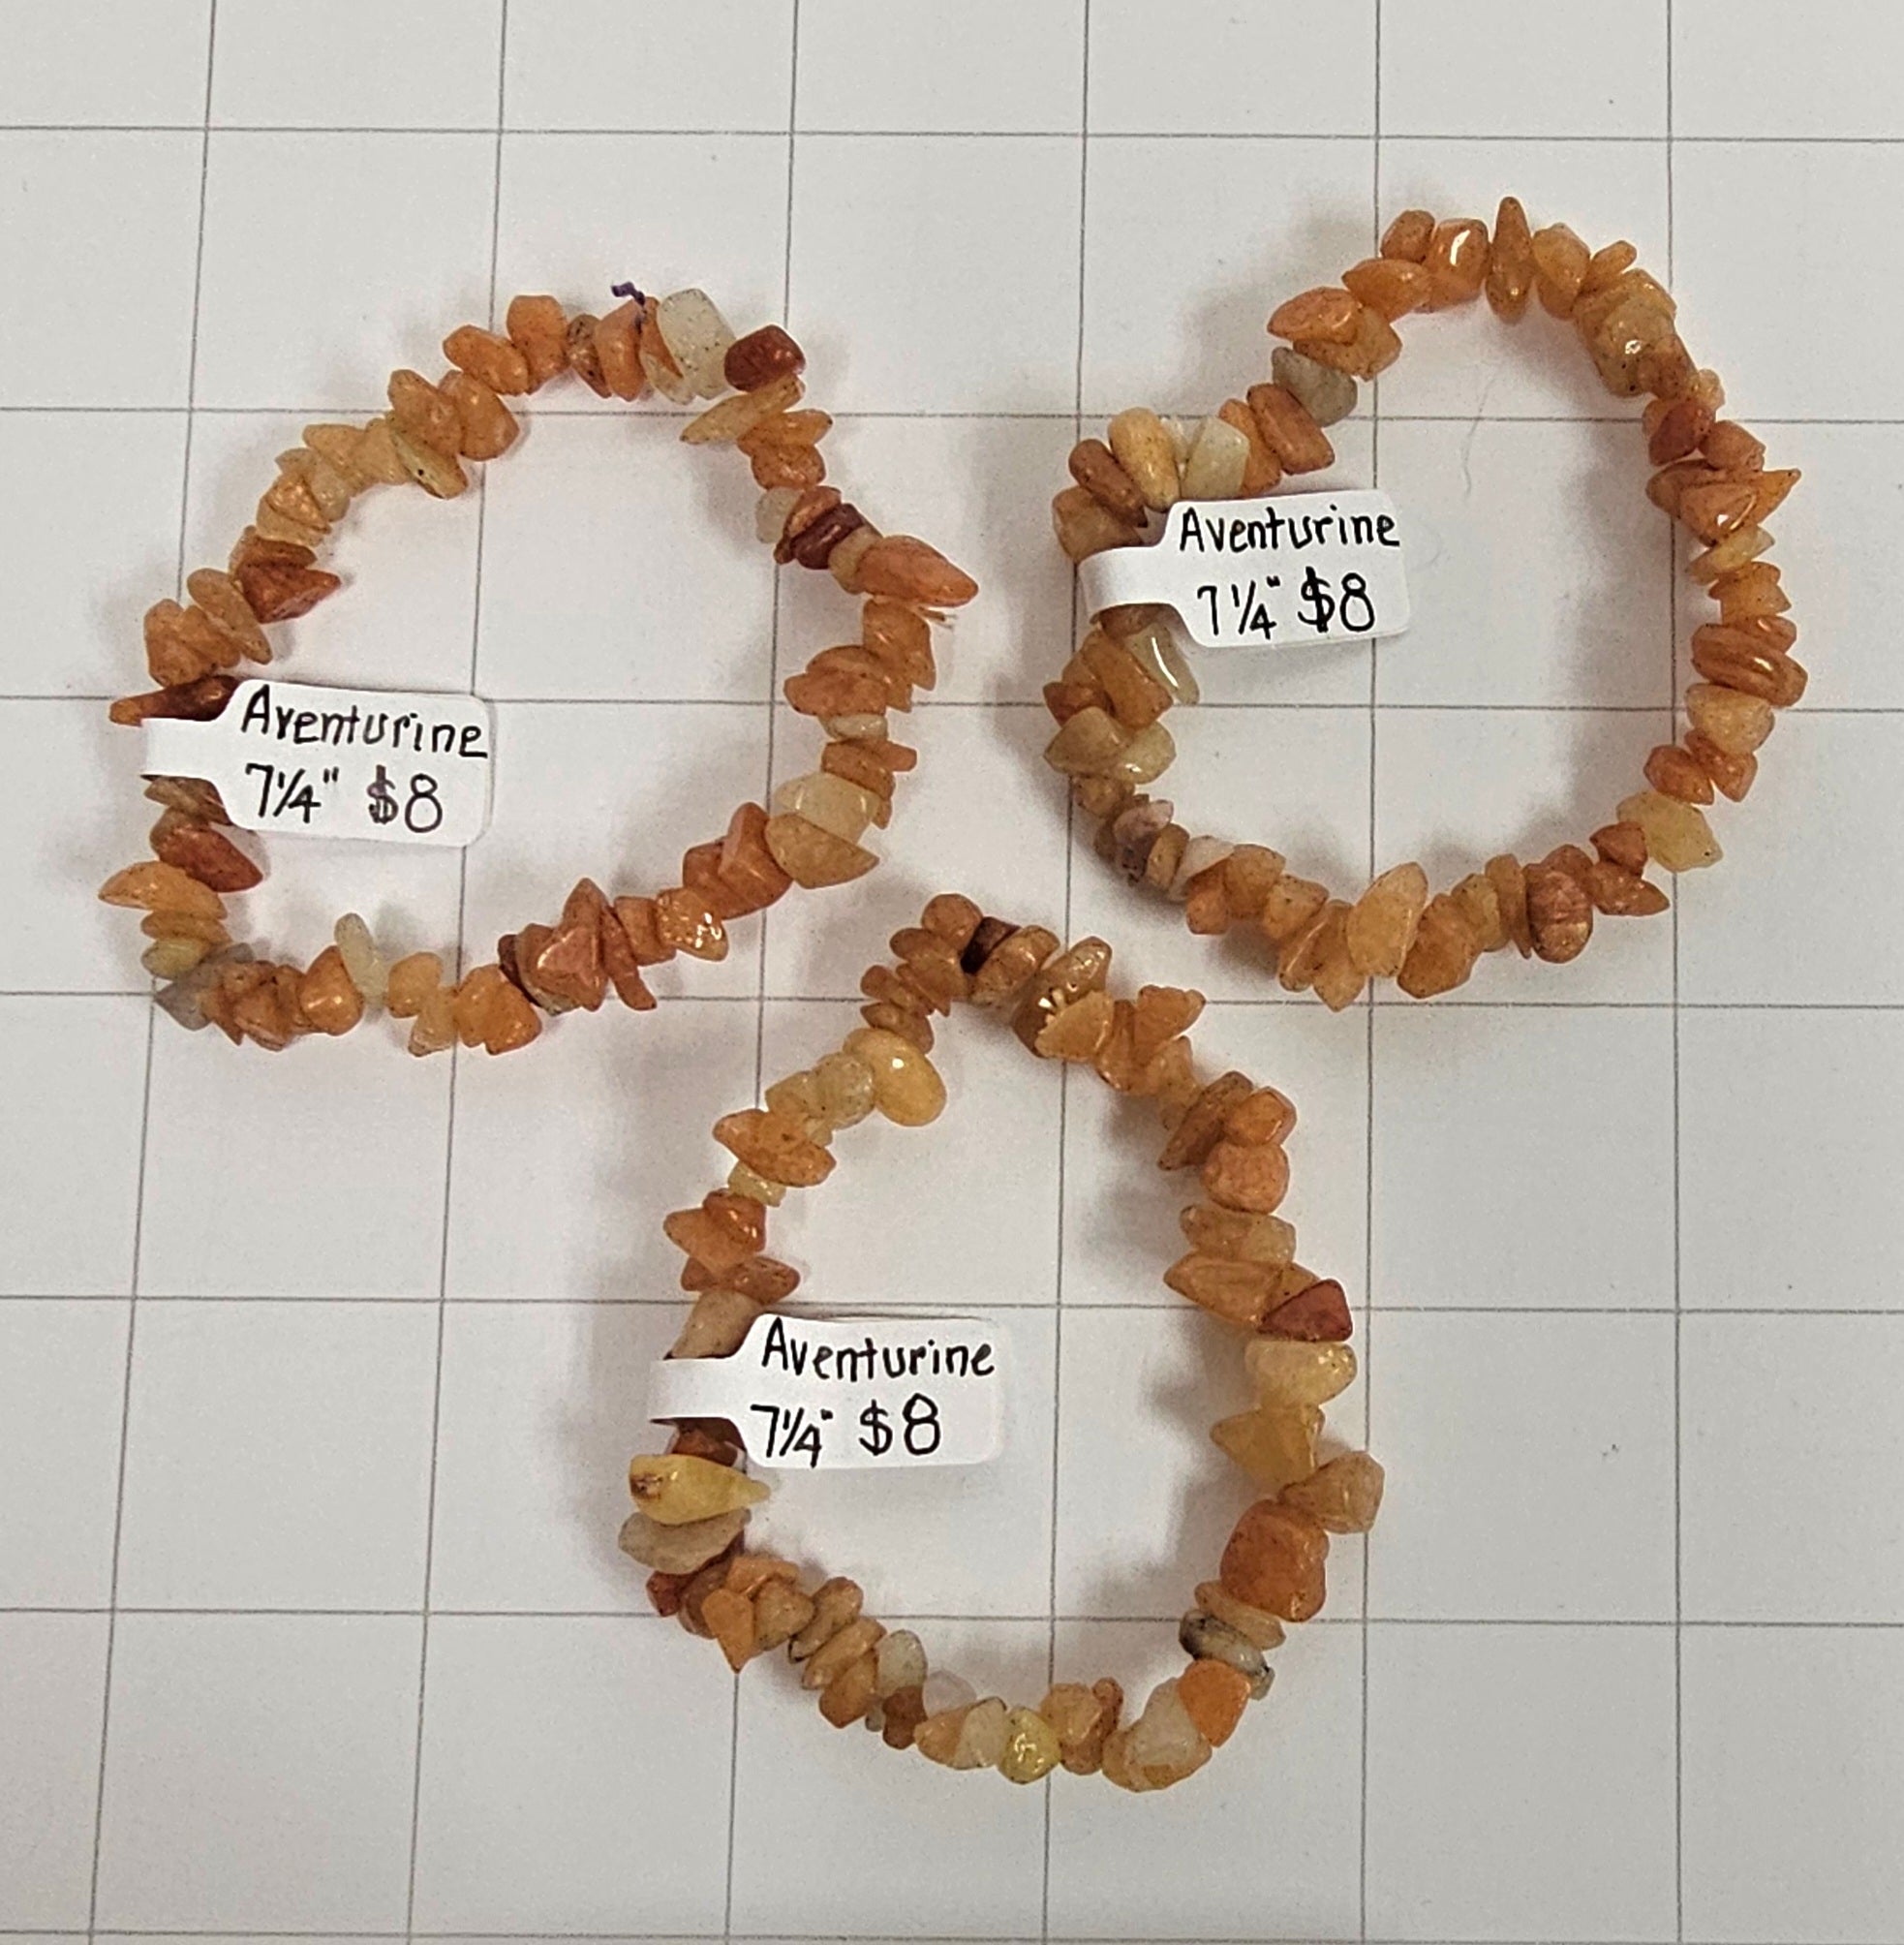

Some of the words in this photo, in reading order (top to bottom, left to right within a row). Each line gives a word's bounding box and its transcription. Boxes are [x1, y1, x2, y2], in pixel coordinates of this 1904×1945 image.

[1179, 504, 1401, 553] Aventurine
[1297, 566, 1376, 633] $8
[240, 684, 489, 759] Aventurine
[367, 764, 444, 833] $8
[761, 1316, 996, 1383] Aventurine
[859, 1392, 941, 1457] $8
